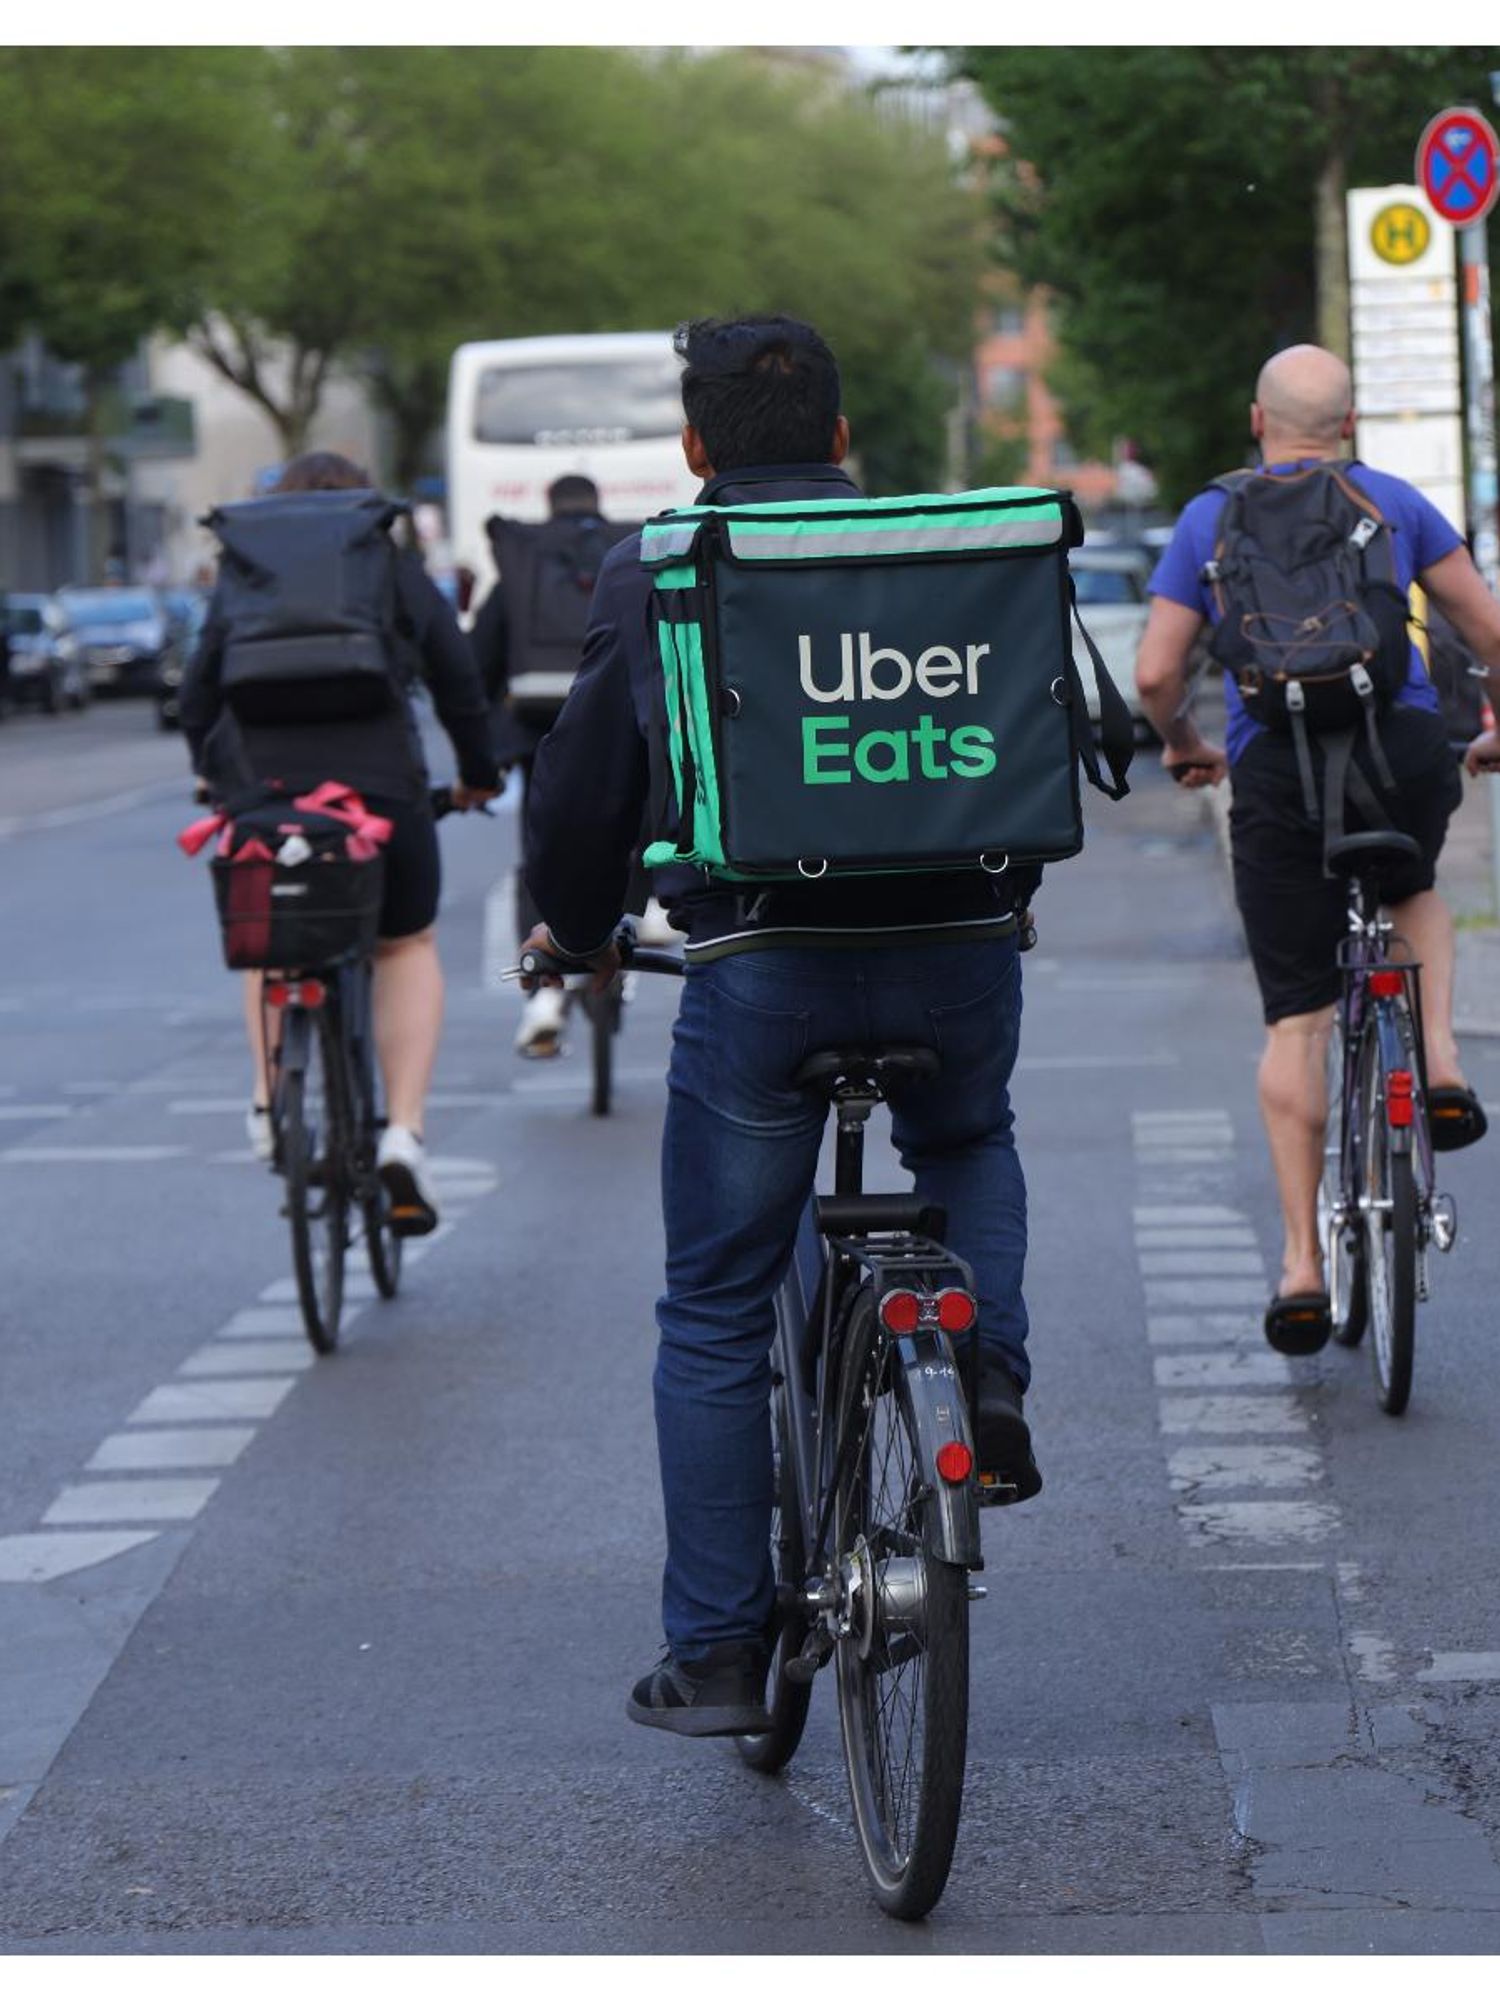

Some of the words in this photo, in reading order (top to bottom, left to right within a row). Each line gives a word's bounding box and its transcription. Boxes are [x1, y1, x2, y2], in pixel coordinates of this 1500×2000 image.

[1386, 217, 1415, 249] H
[798, 632, 990, 703] Uber
[801, 714, 997, 785] Eats
